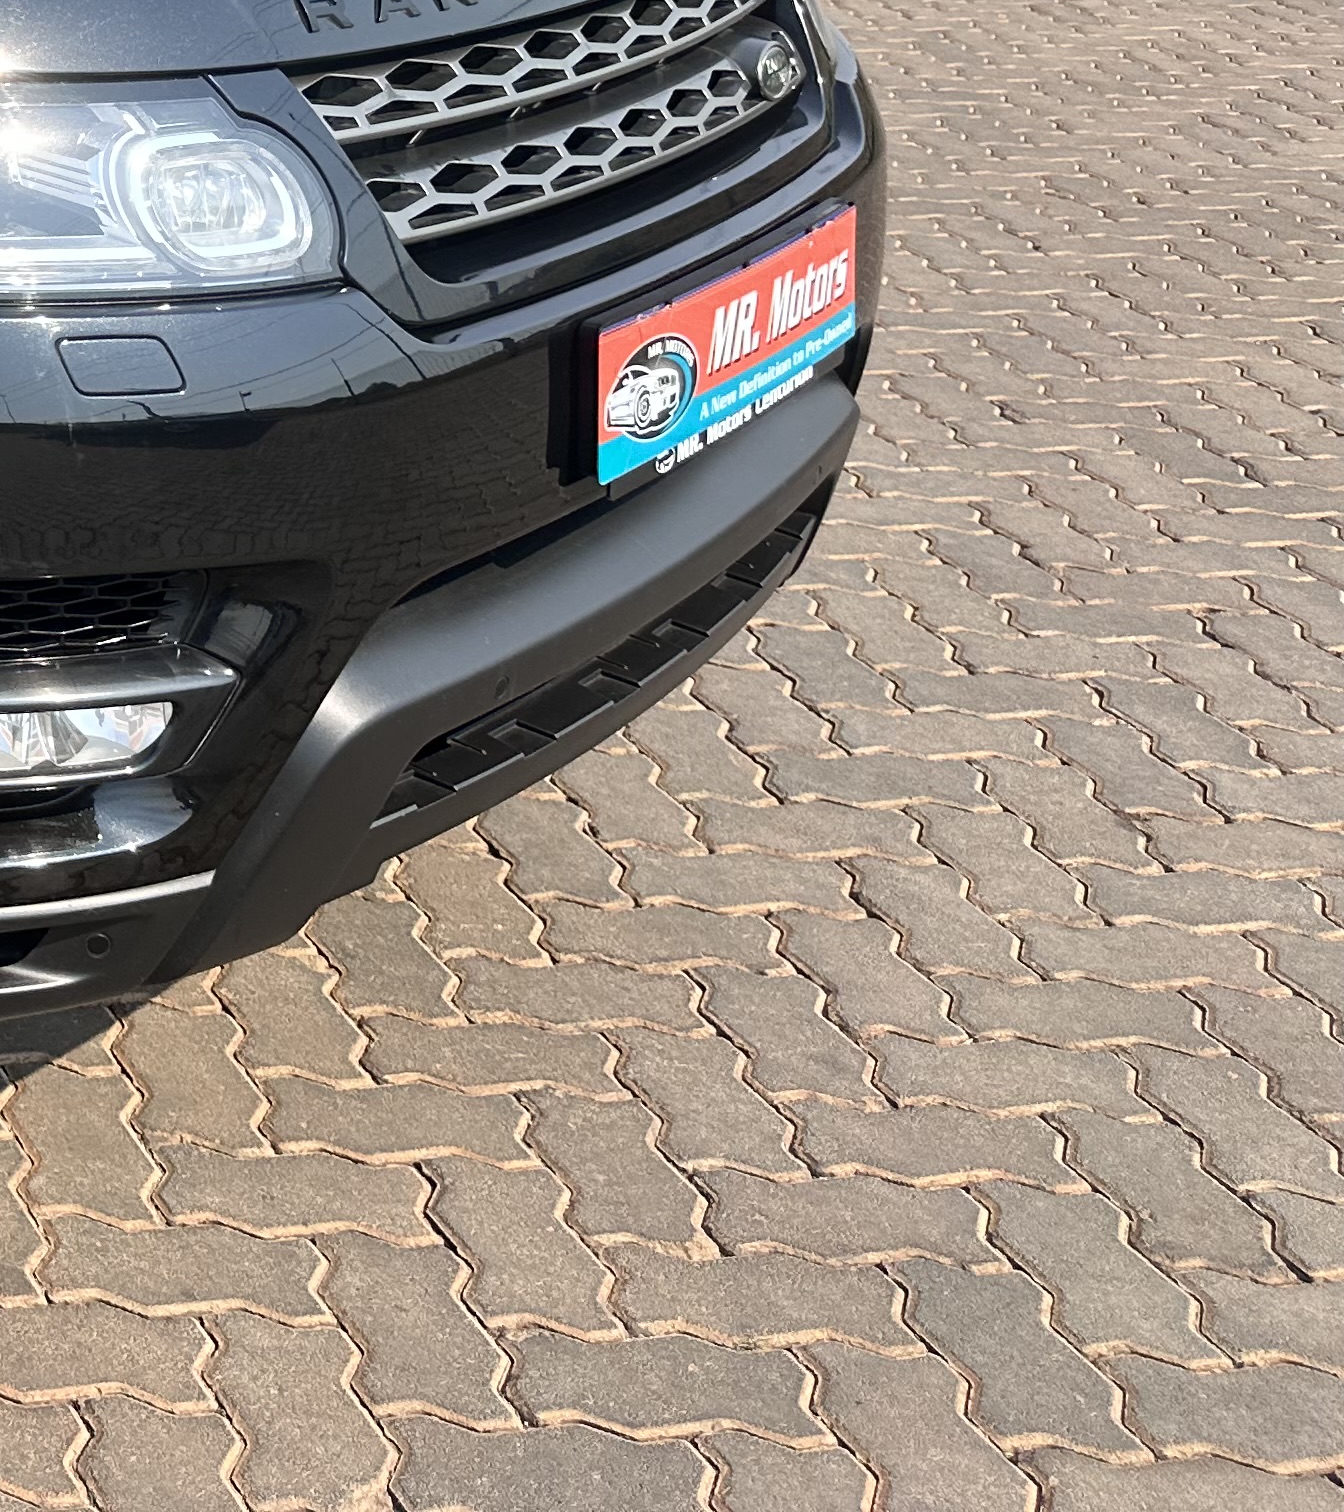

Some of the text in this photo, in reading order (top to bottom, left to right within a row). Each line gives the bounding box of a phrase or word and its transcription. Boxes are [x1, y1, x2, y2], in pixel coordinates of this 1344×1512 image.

[648, 339, 694, 367] MR. MOTORS
[707, 248, 849, 376] MR. Motors
[700, 312, 852, 421] A New Definition to Pre-Owned
[676, 432, 704, 463] MR.
[707, 404, 752, 444] Motors
